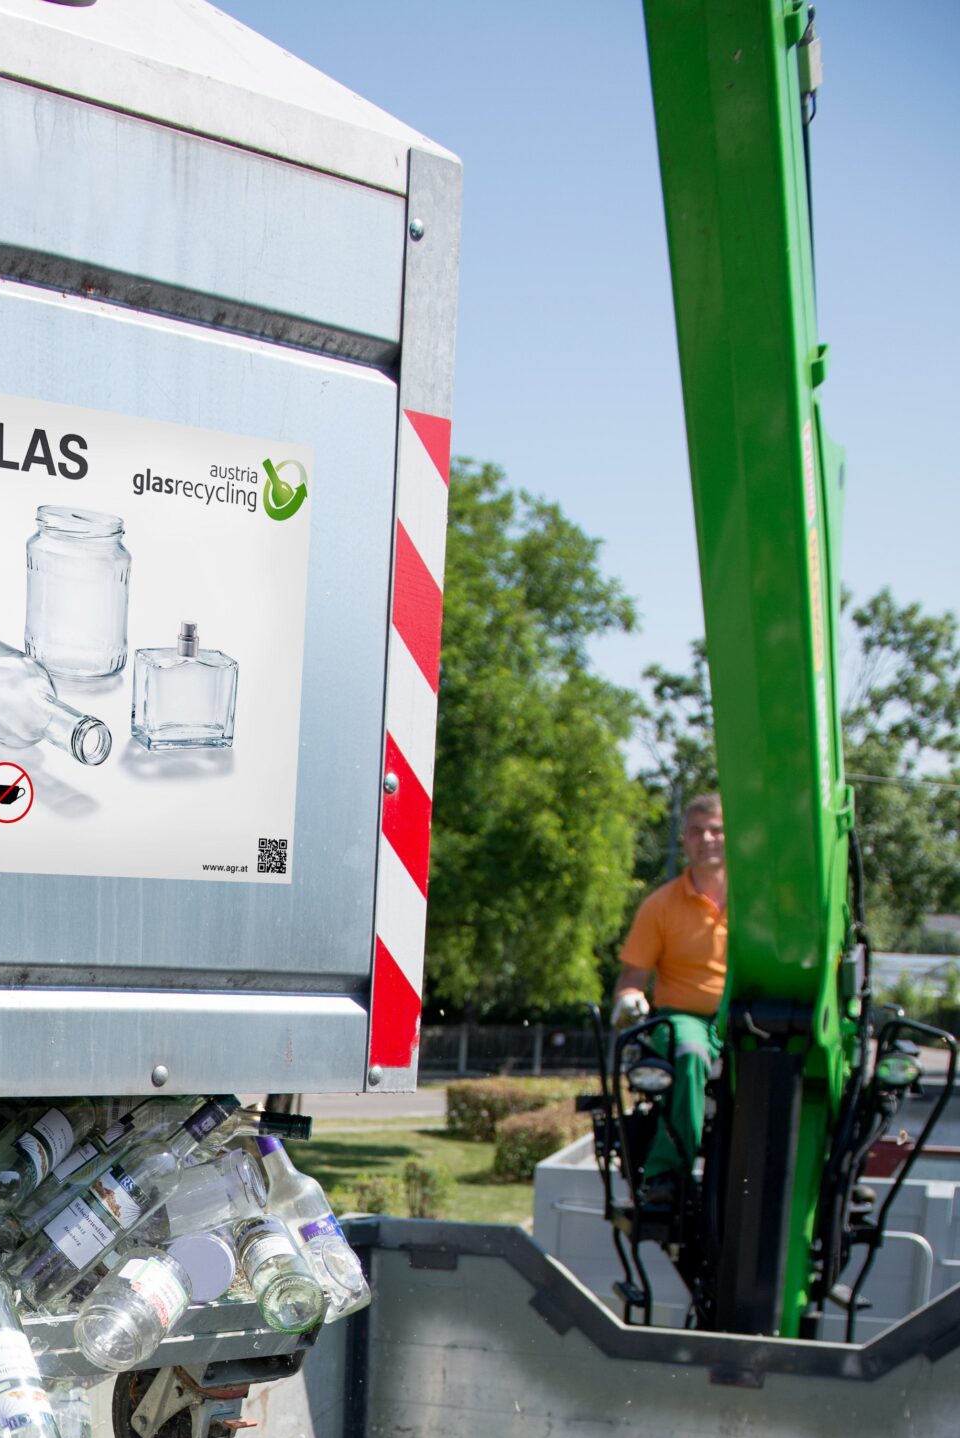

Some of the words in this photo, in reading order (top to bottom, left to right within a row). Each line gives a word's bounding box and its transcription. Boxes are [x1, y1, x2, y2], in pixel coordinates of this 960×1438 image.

[210, 464, 258, 484] austria
[132, 468, 257, 512] glasrecycling
[202, 864, 248, 873] www.agr.at
